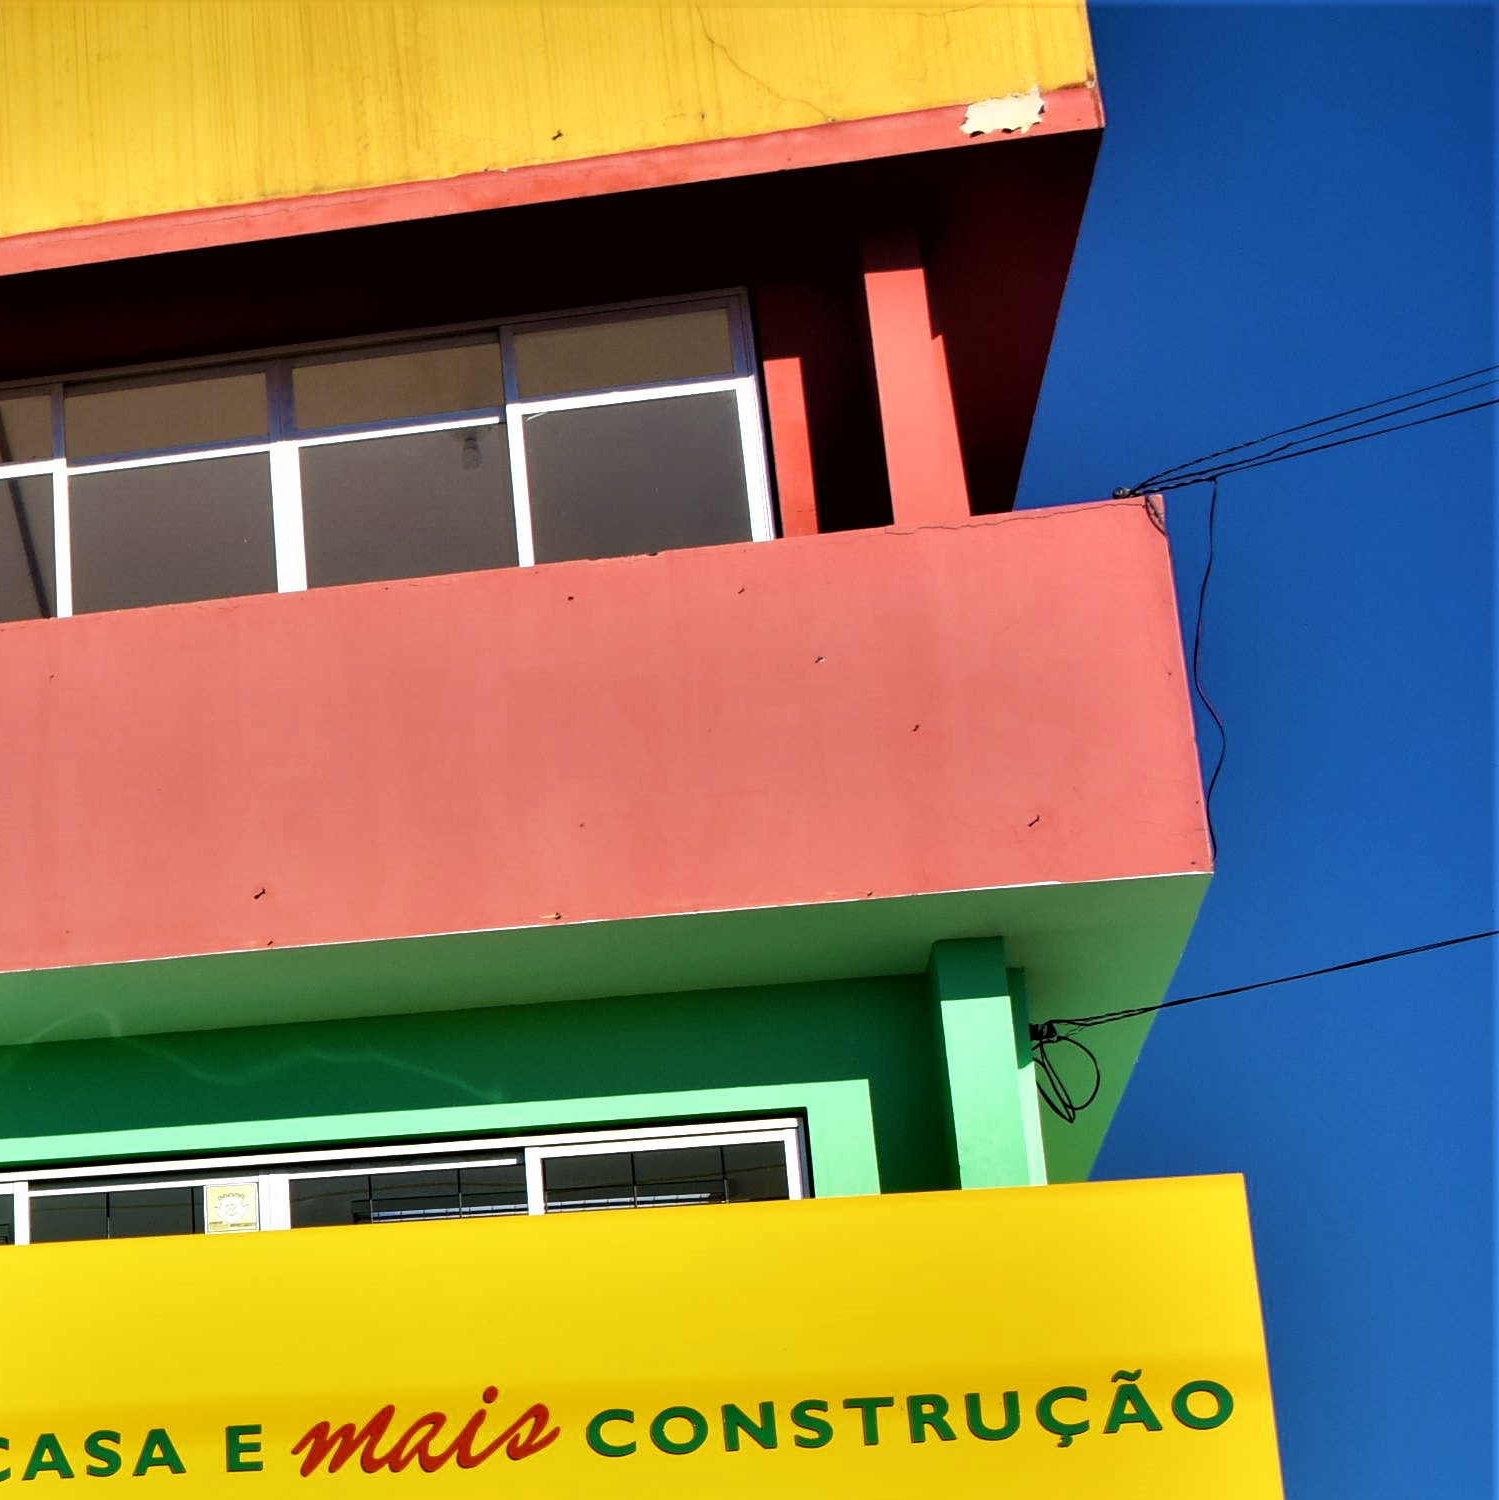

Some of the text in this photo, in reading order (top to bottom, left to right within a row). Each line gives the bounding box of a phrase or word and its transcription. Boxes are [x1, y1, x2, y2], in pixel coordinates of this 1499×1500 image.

[225, 1424, 263, 1473] E
[292, 1386, 561, 1478] mais
[586, 1369, 1234, 1457] CONSTRUÇÃO
